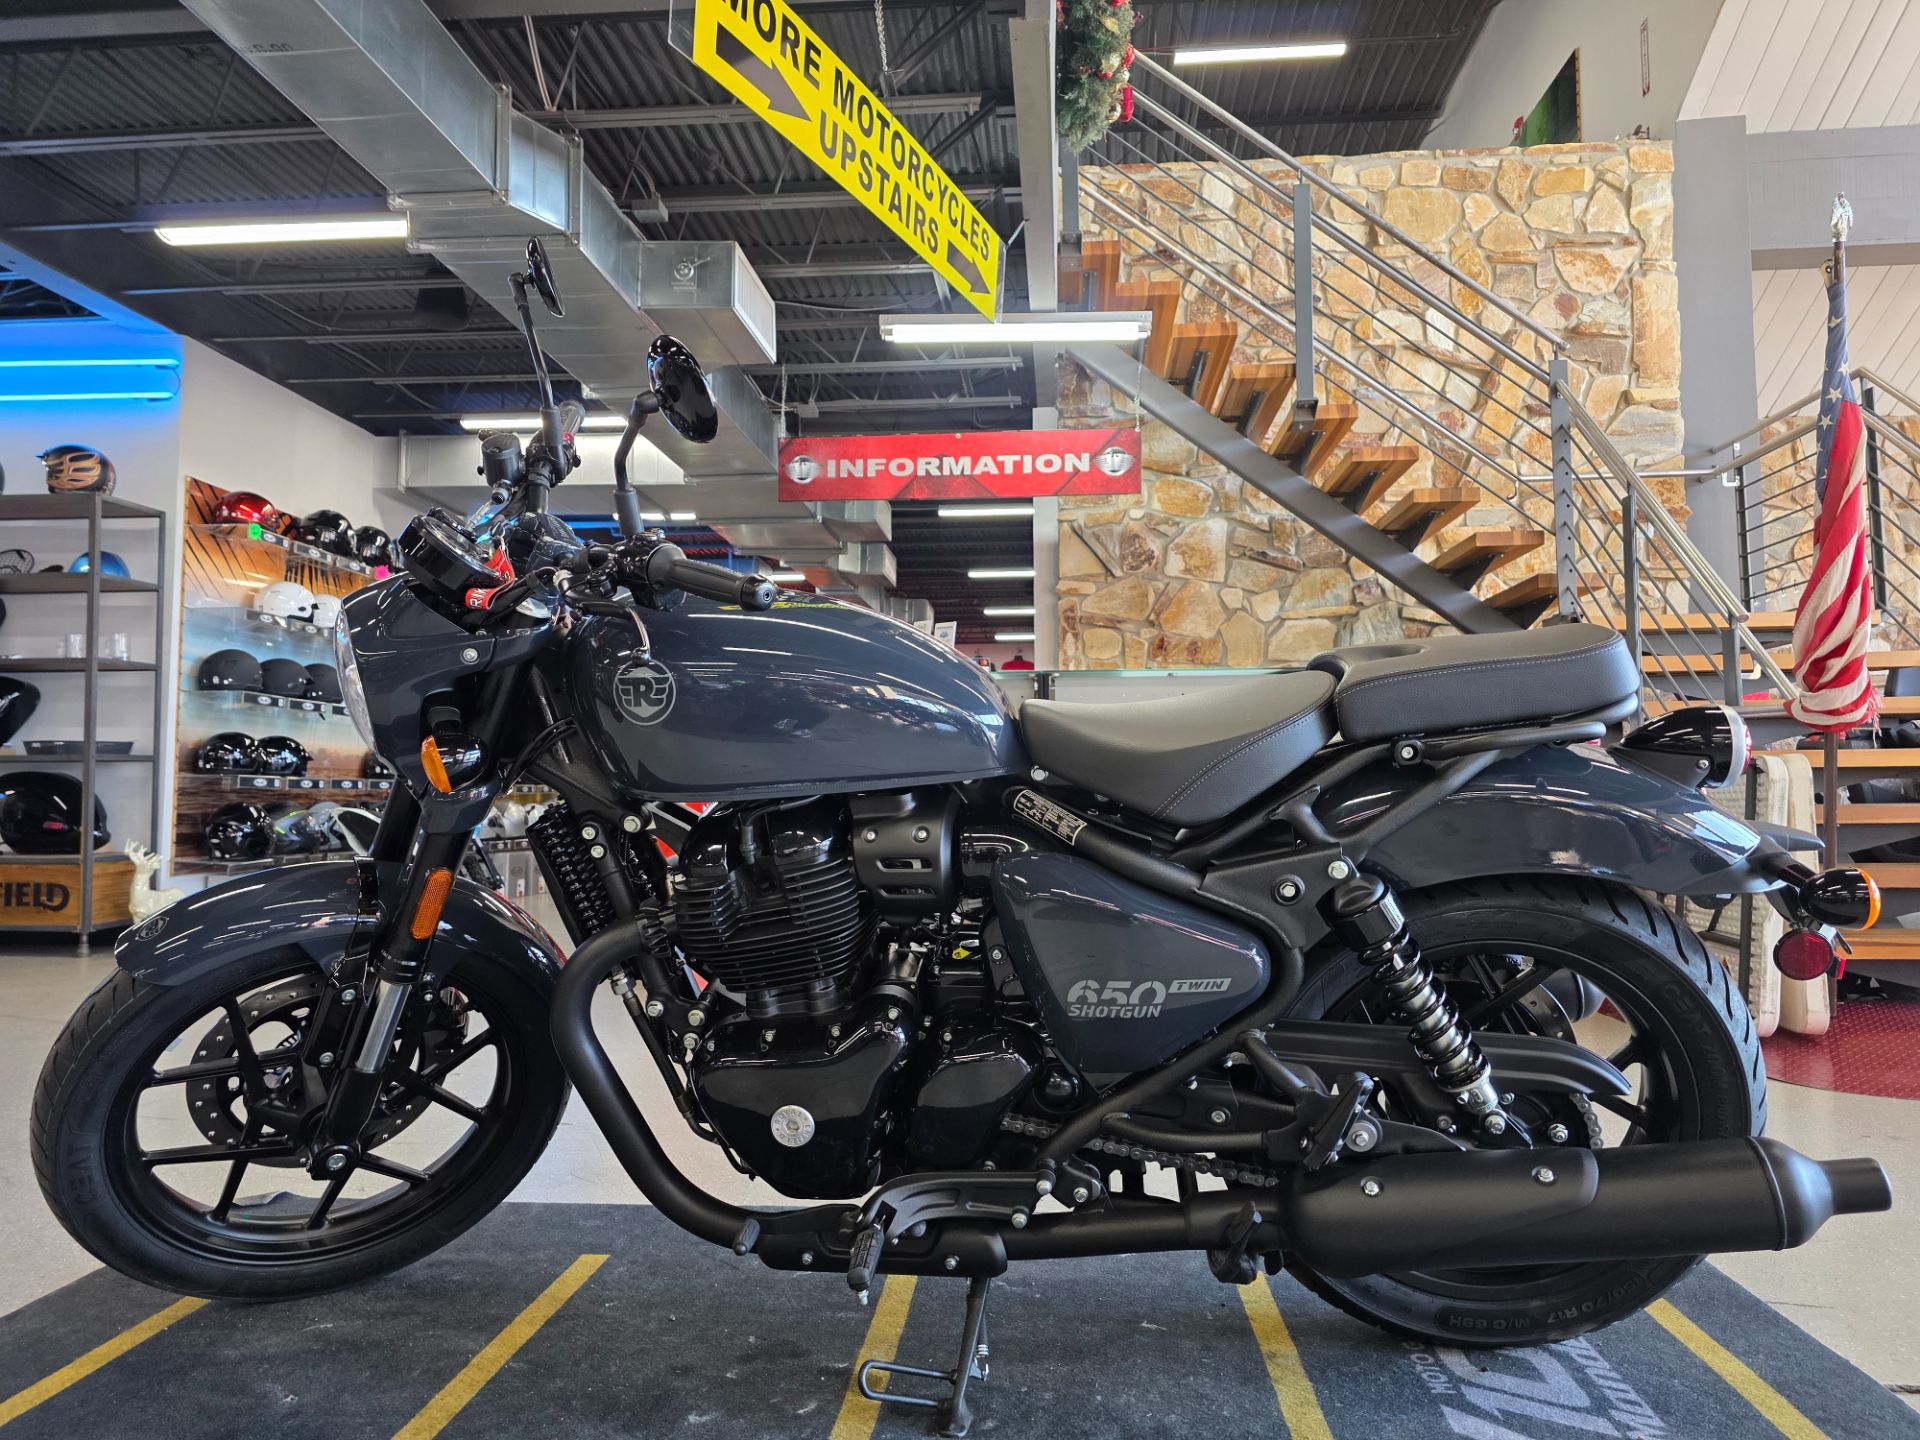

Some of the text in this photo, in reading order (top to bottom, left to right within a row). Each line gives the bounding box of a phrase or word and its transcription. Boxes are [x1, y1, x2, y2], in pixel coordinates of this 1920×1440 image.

[833, 66, 991, 262] MOTORCYCLES
[820, 110, 939, 255] UPSTAIRS
[827, 453, 1091, 478] INFORMATION
[1067, 979, 1224, 1005] 650 TWIN
[1068, 1004, 1163, 1019] SHOTGUN
